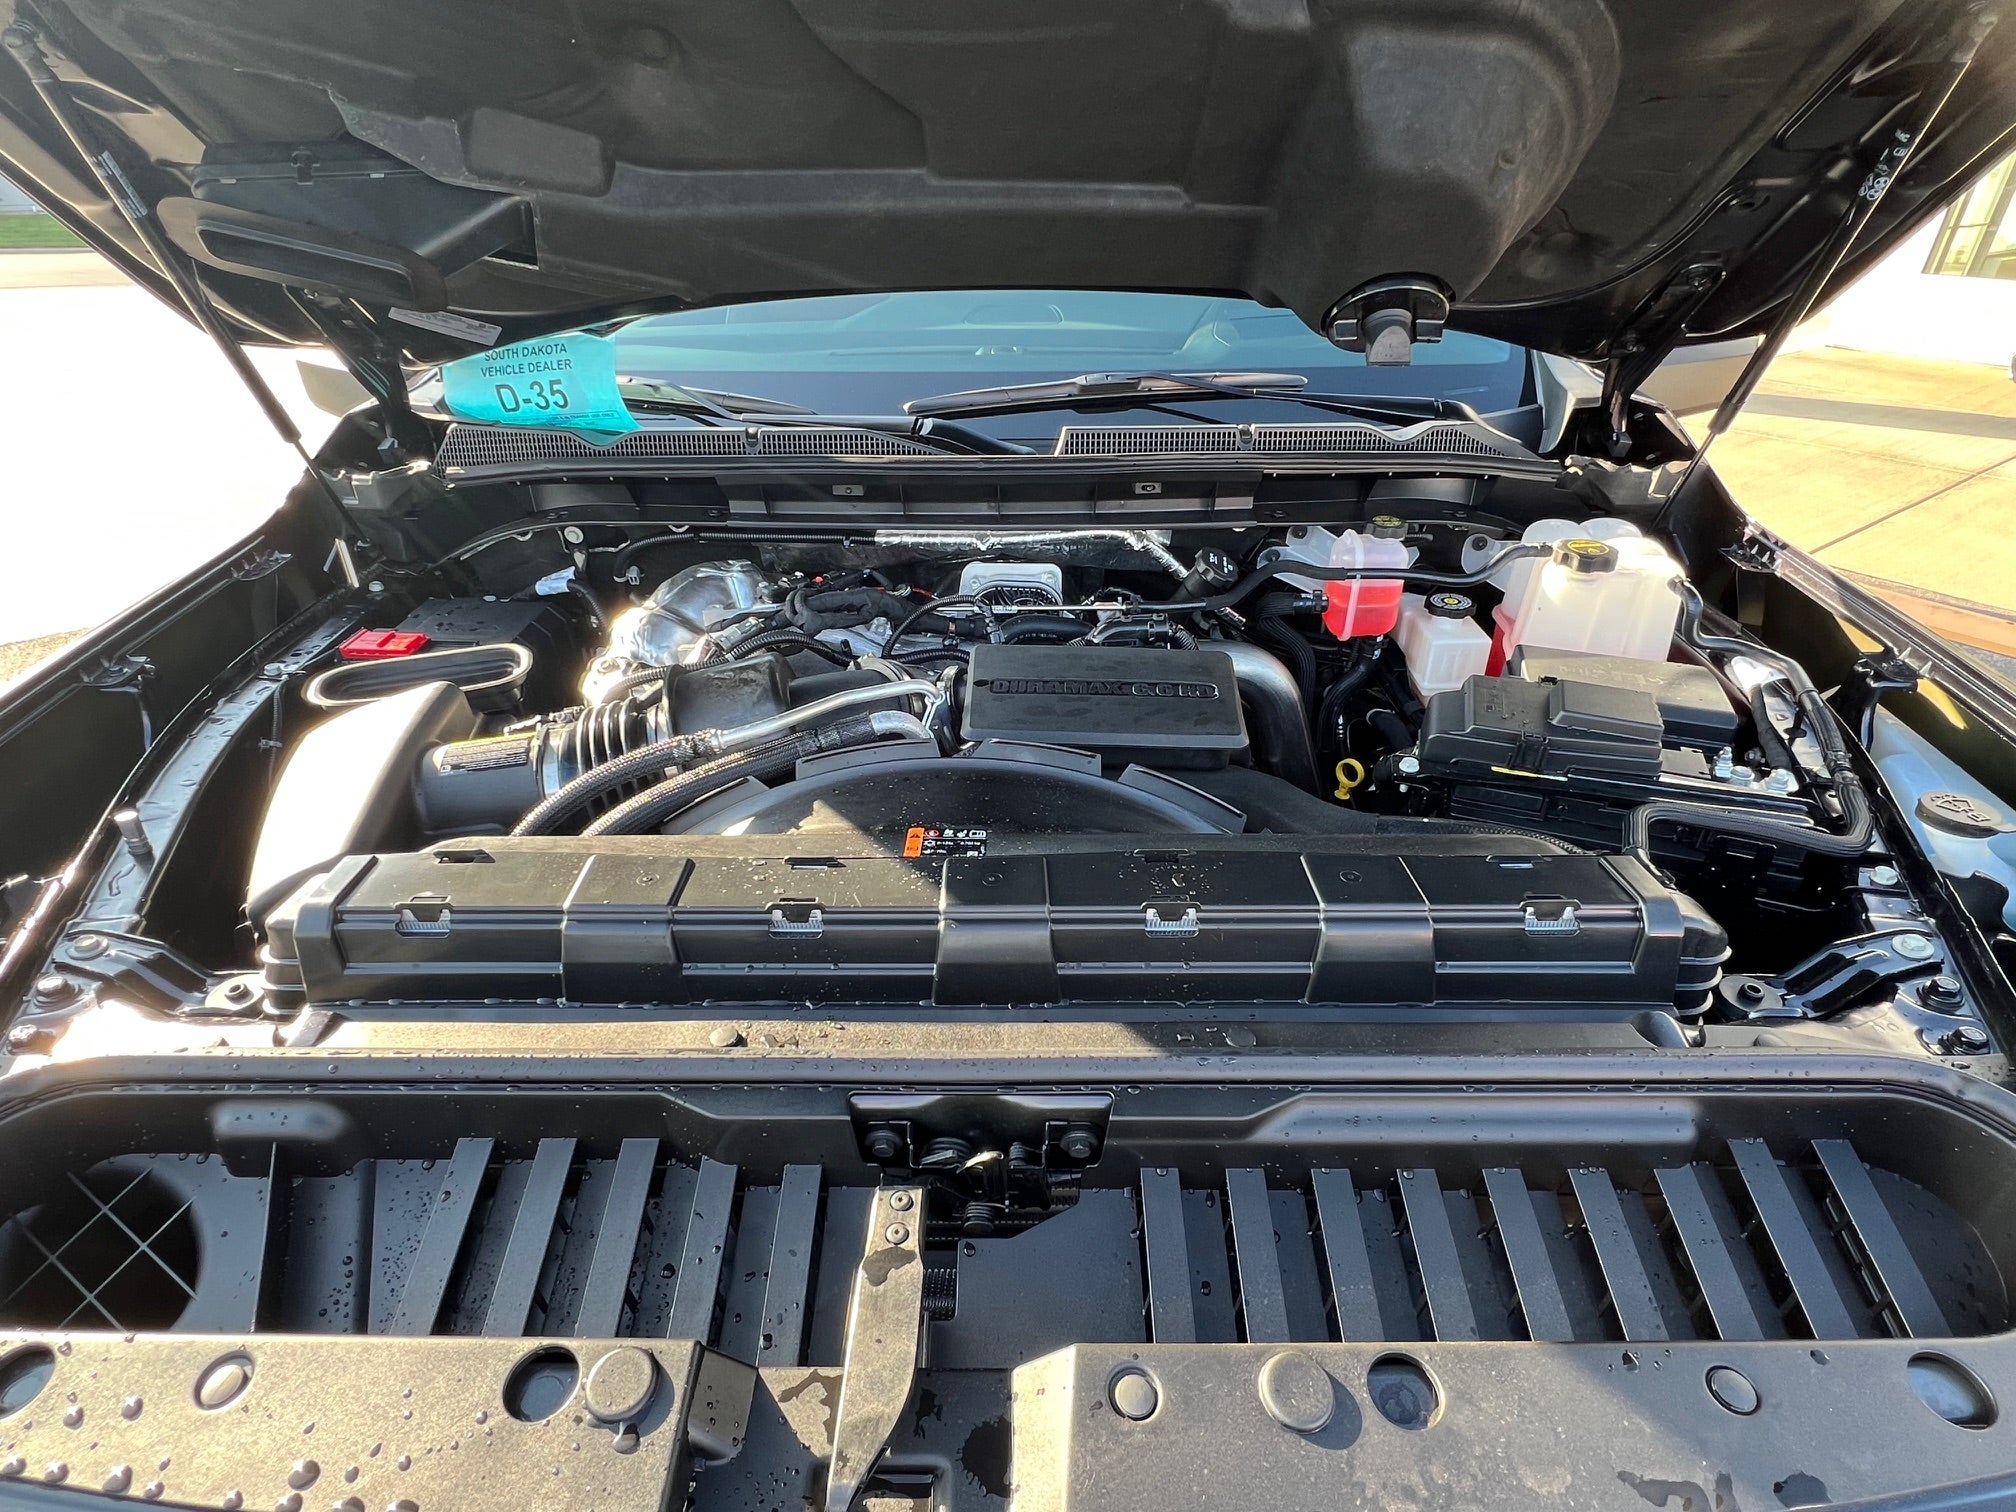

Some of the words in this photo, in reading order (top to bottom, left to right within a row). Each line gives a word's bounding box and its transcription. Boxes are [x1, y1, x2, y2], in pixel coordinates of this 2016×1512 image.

[484, 348, 519, 361] SOUTH
[522, 344, 567, 357] DAKOTA
[481, 364, 525, 377] VEHICLE
[528, 359, 572, 373] DEALER
[495, 379, 569, 412] D-35
[991, 680, 1124, 695] DURAMAX
